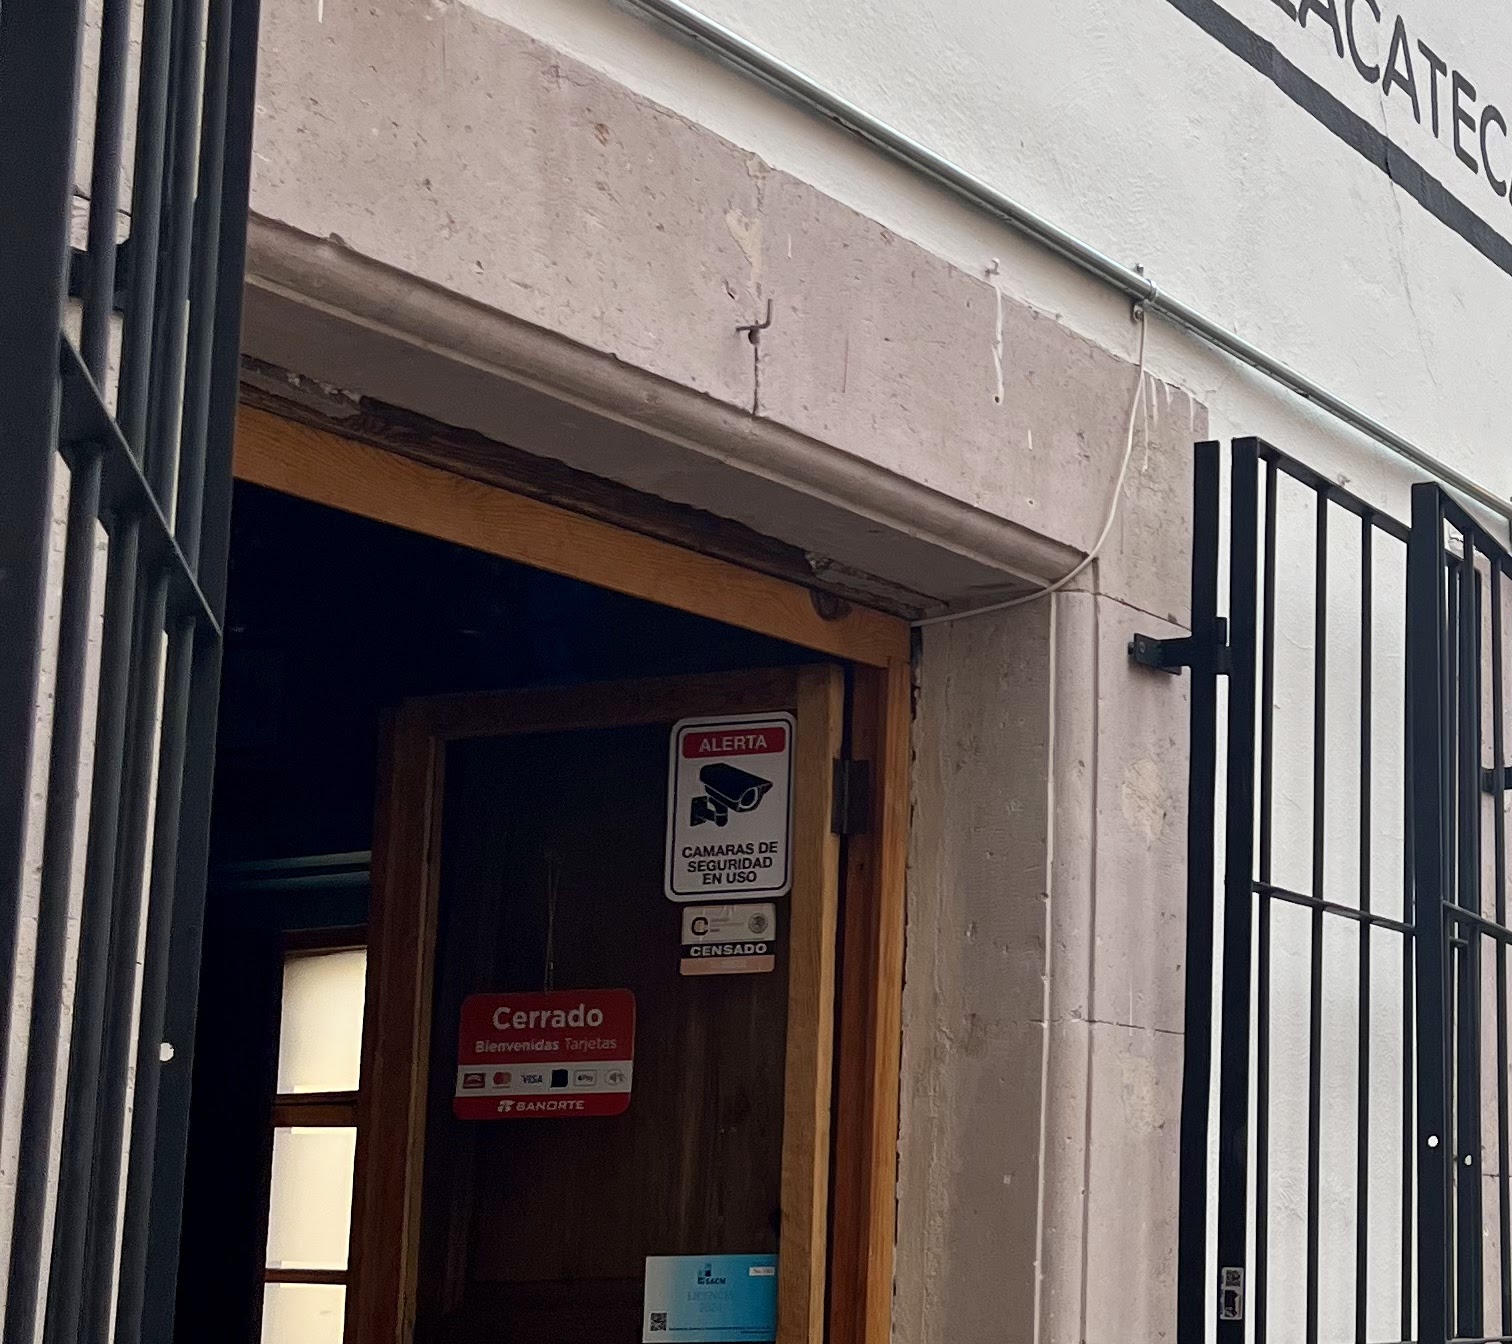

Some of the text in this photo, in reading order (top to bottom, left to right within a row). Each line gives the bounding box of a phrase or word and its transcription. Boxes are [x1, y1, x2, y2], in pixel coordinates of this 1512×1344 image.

[699, 734, 768, 753] ALERTA
[682, 841, 778, 858] CAMARAS DE
[687, 857, 773, 873] SEGURIDAD
[702, 871, 757, 885] EN USO
[690, 942, 768, 957] CENSADO
[492, 1003, 604, 1031] Cerrado
[475, 1037, 617, 1053] Bienvenidas Tarjetas
[520, 1073, 543, 1085] VISA
[516, 1099, 585, 1112] BANORTE
